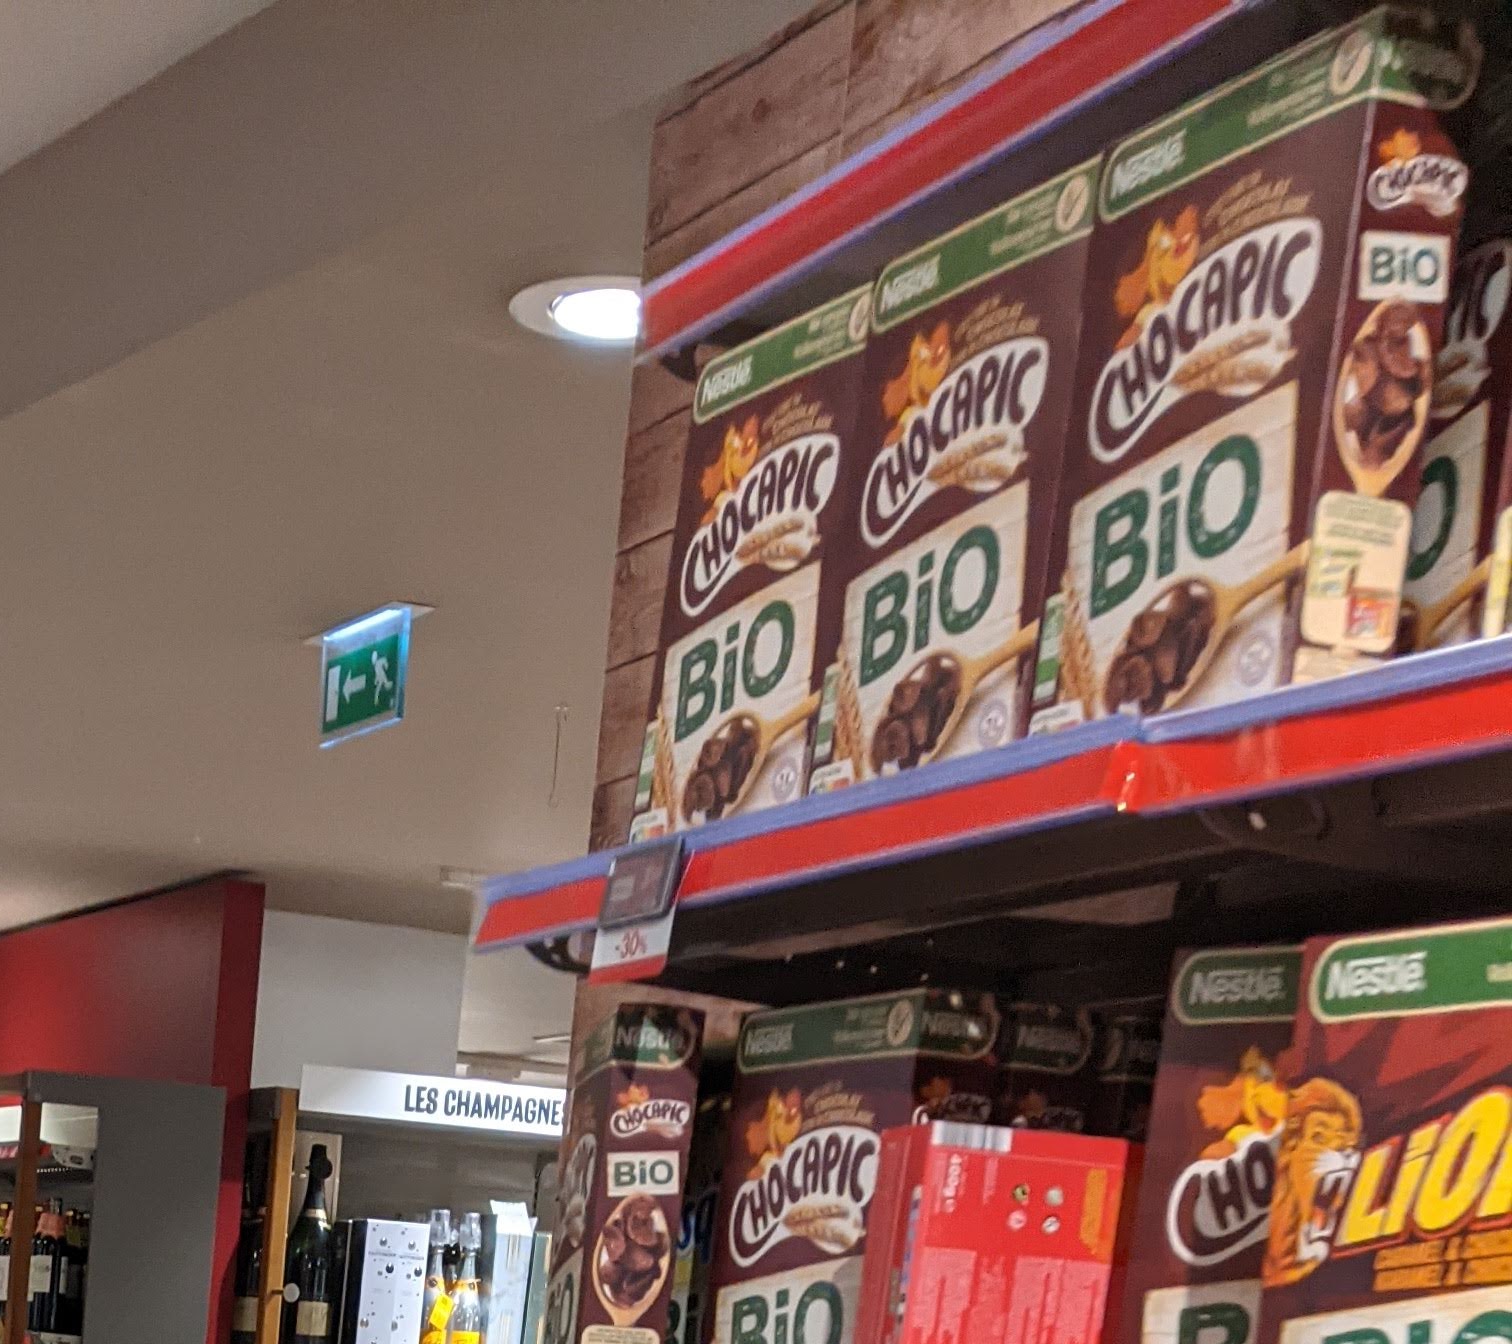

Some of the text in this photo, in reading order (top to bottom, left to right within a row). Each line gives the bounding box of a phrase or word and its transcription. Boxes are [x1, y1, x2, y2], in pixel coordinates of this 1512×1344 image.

[1095, 231, 1313, 455] CHOCAPIC
[865, 350, 1043, 540] CHOCAPIC
[684, 442, 833, 609] CHOCAPIC
[404, 1084, 439, 1114] LES
[614, 1103, 687, 1132] CHOCAPIC
[734, 1133, 876, 1258] CHOCAPIC
